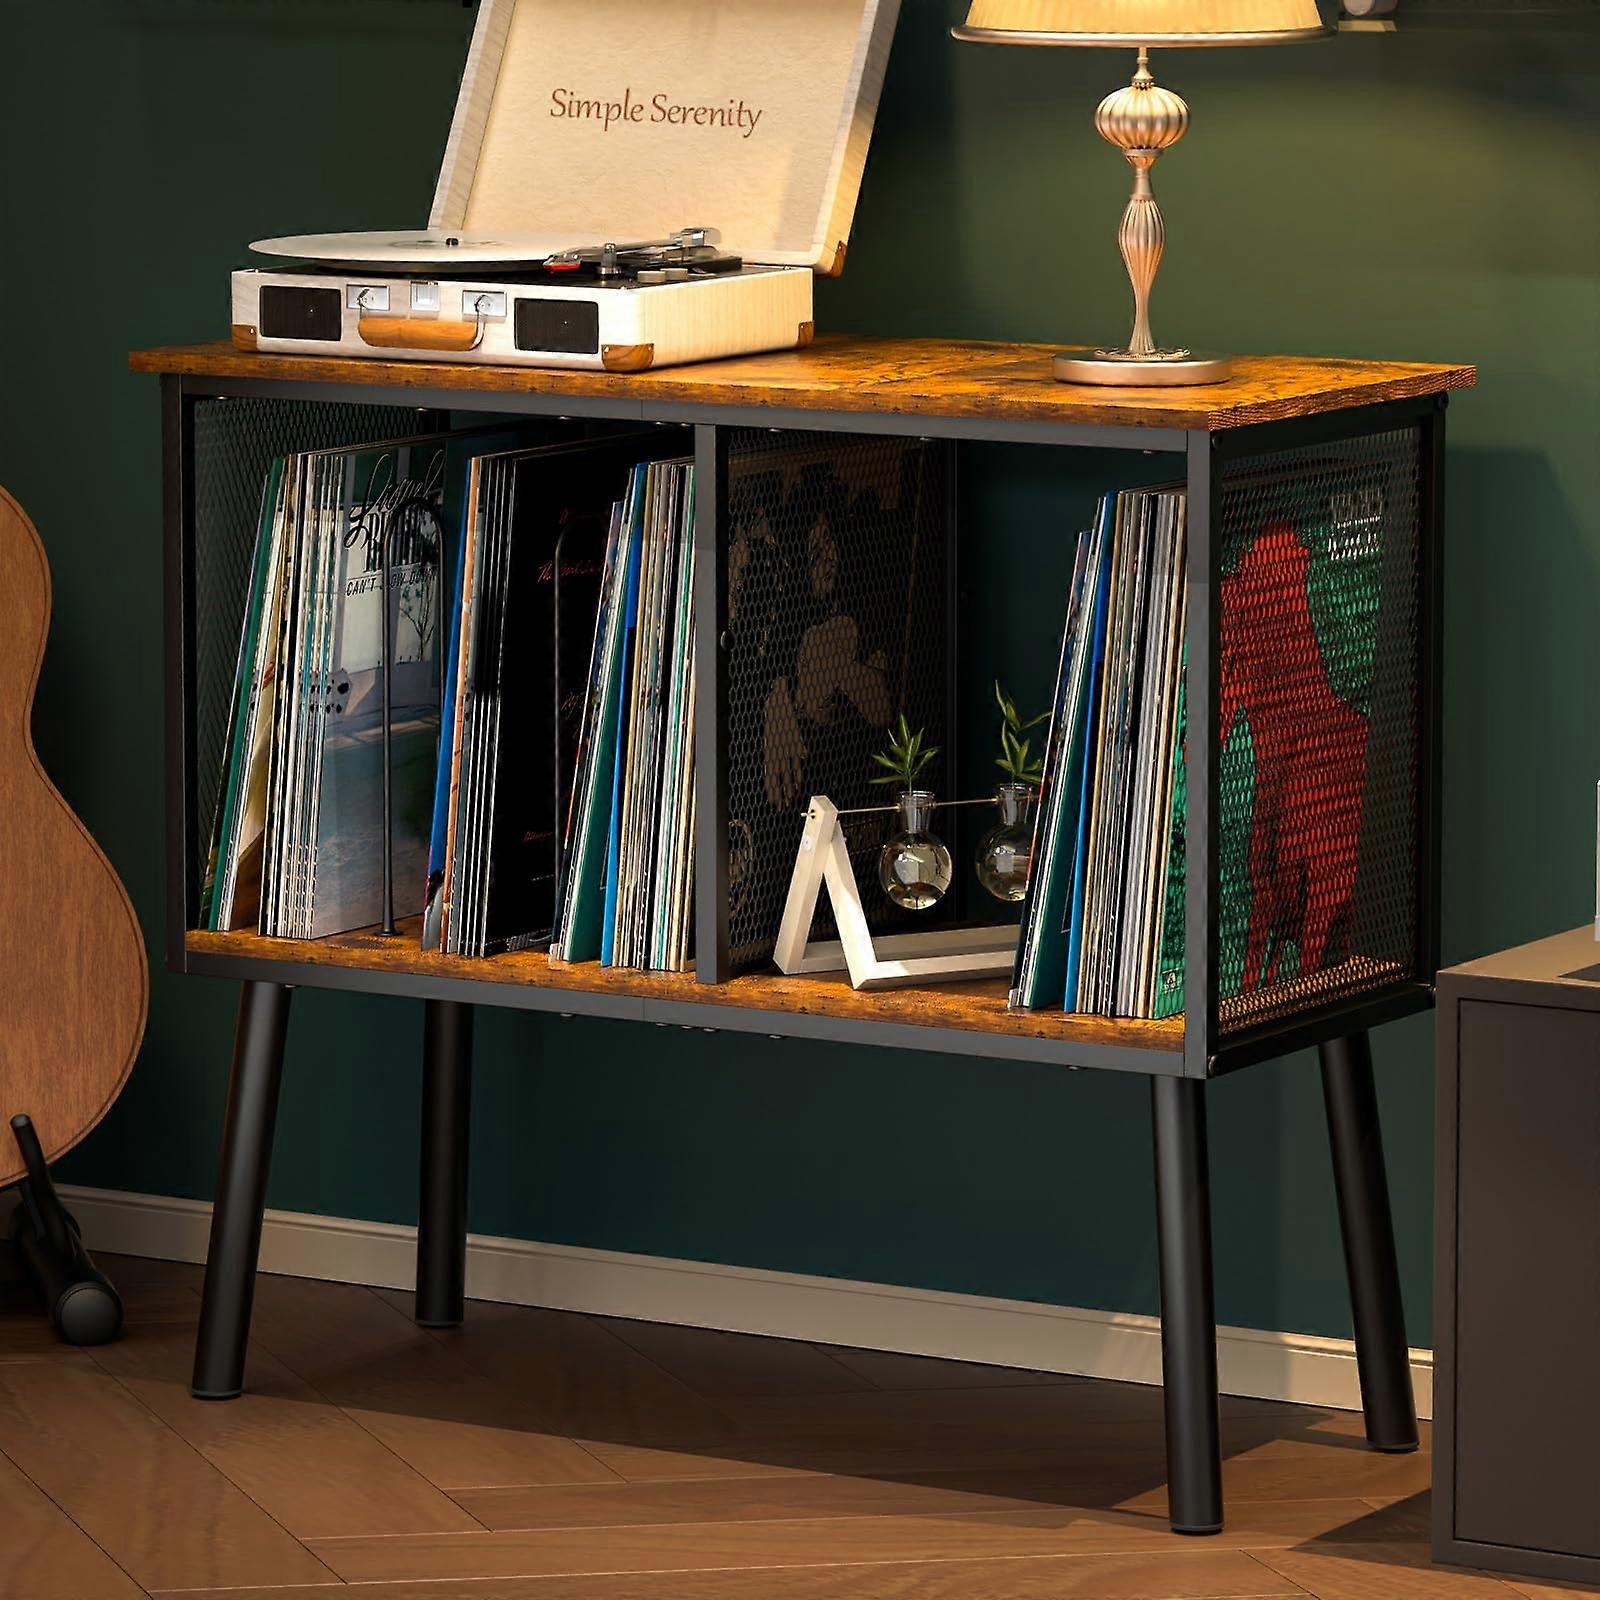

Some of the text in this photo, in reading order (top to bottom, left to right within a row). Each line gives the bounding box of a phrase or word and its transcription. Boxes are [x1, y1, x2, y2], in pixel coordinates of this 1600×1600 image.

[550, 88, 763, 138] Simple Serenity
[346, 577, 377, 597] CAN'T
